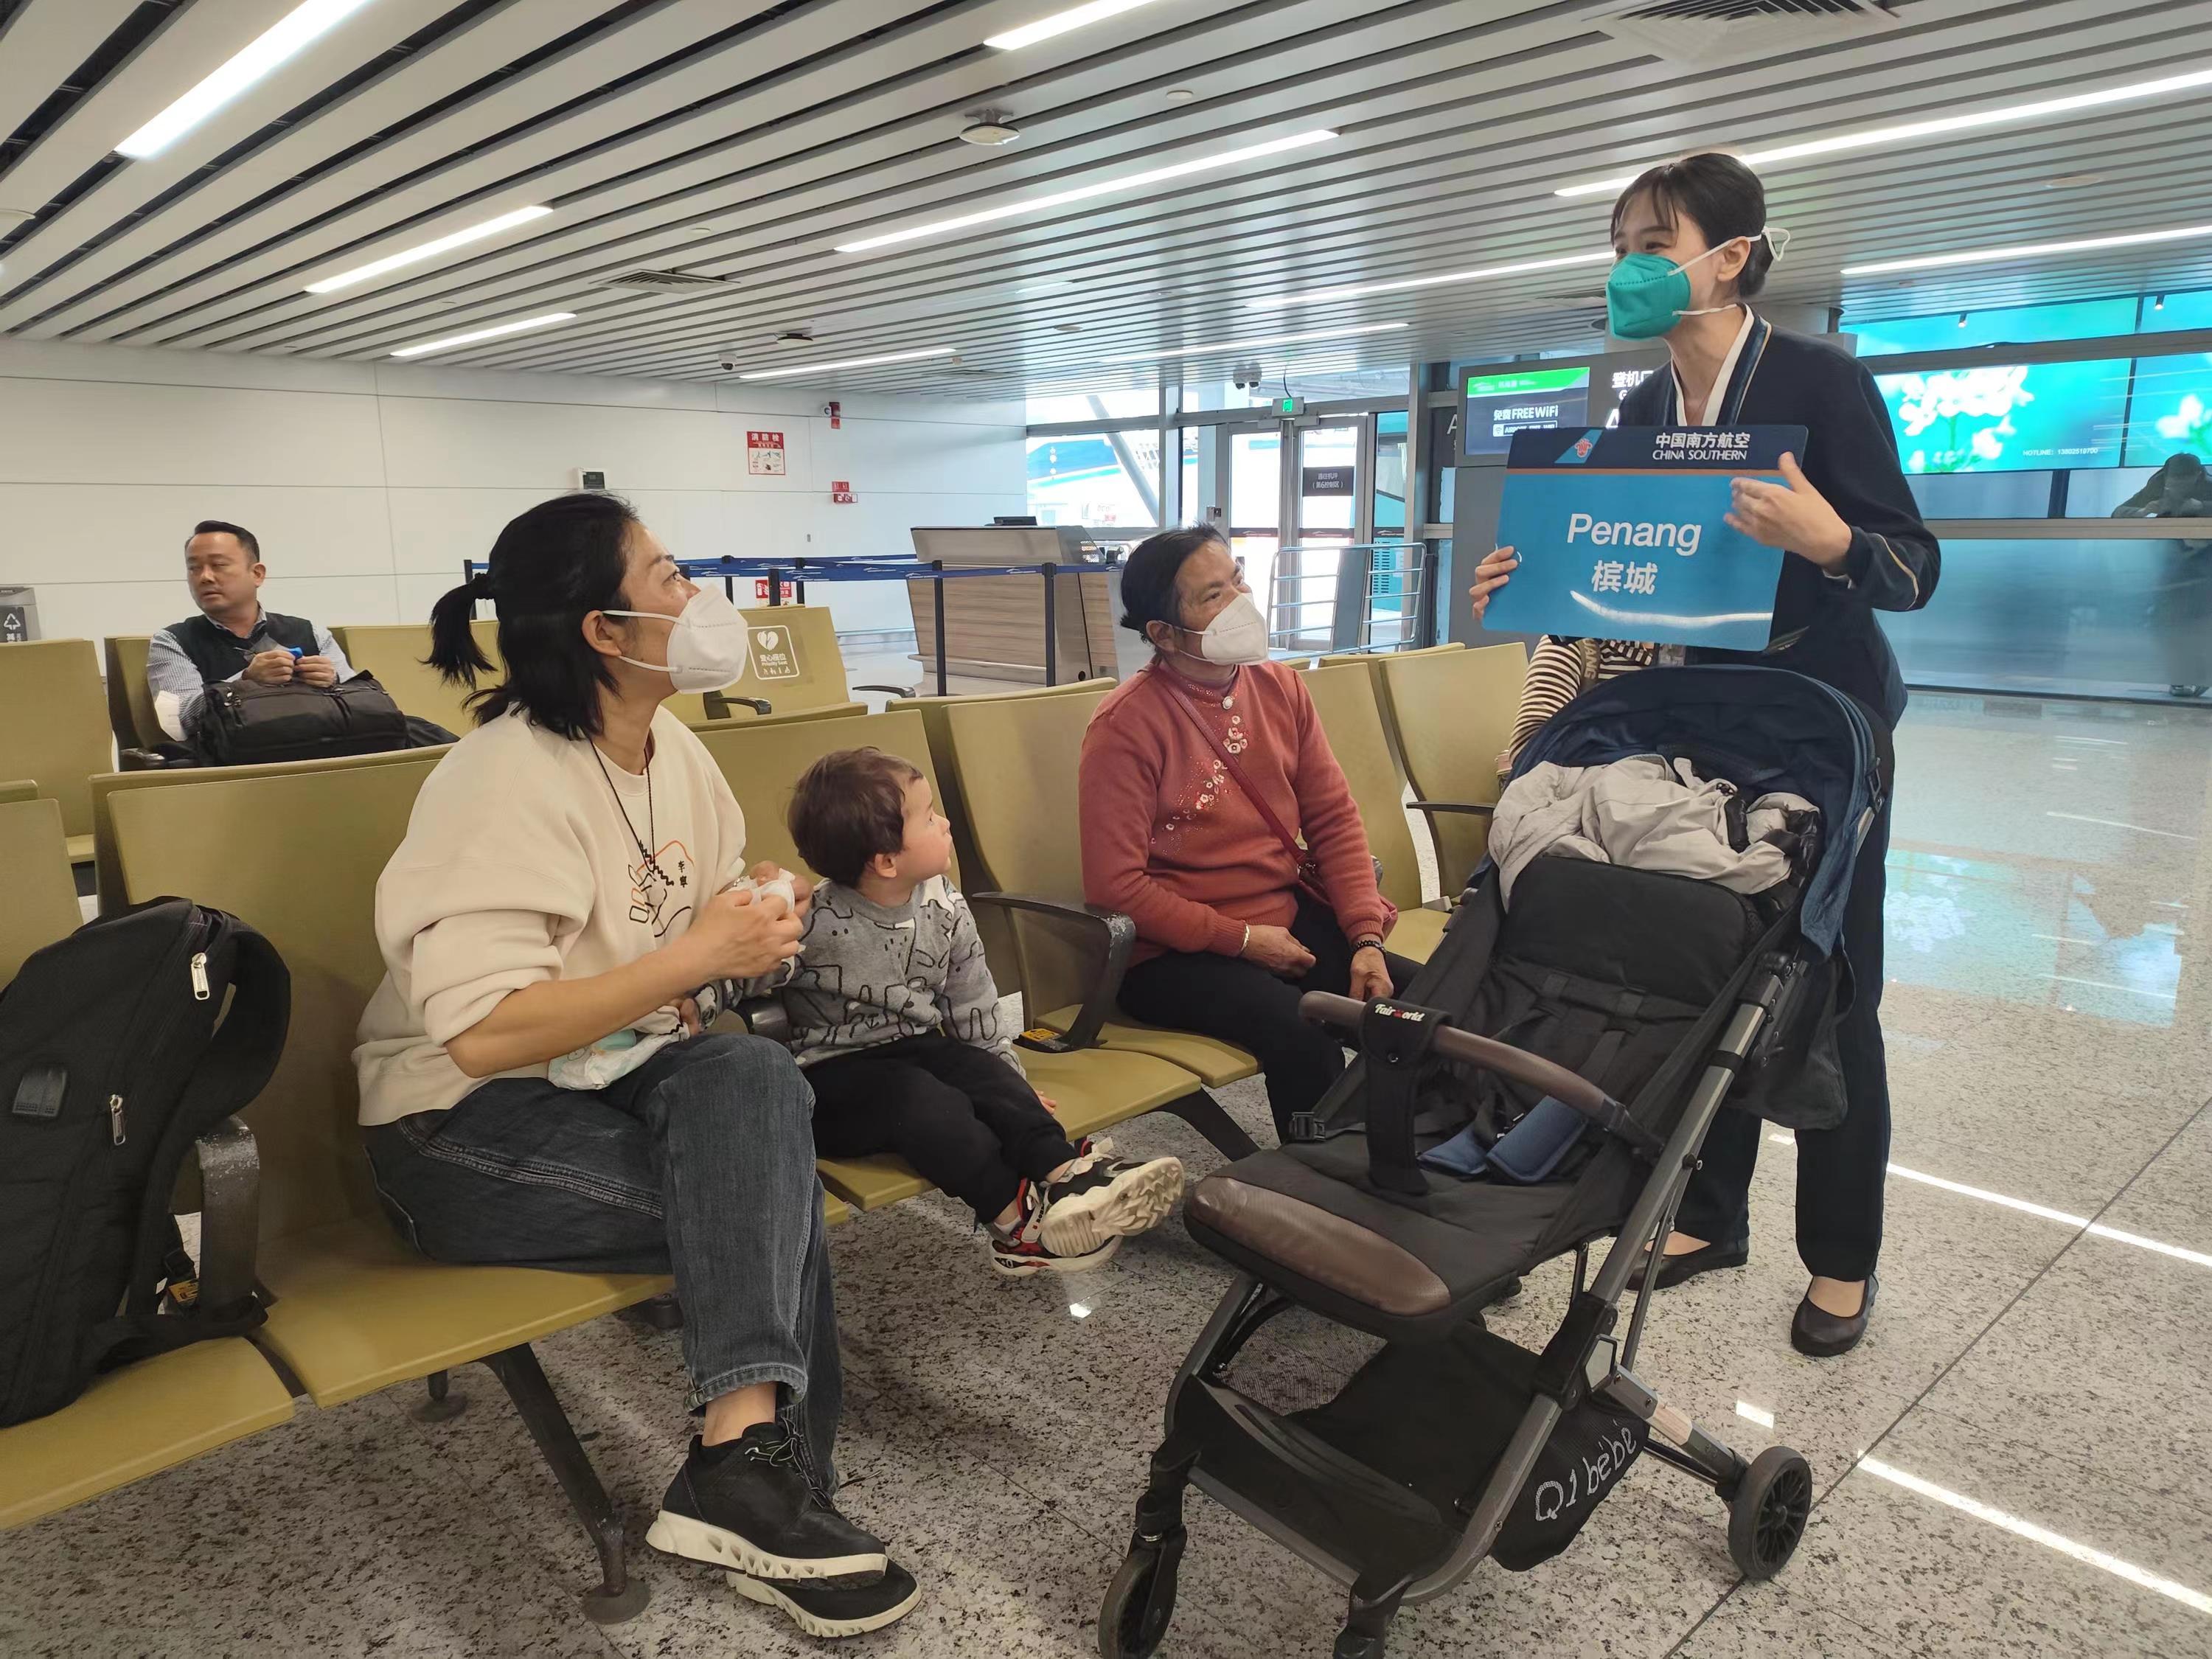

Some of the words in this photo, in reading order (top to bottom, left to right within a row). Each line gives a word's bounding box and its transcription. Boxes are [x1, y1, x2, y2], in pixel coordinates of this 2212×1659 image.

[1512, 407, 1534, 420] FREE
[1534, 405, 1559, 418] WiFi
[1655, 432, 1750, 448] 中国南方航空
[1652, 450, 1685, 460] CHINA
[1687, 450, 1747, 461] SOUTHERN
[1567, 513, 1702, 557] Penang
[1591, 560, 1658, 595] 槟城
